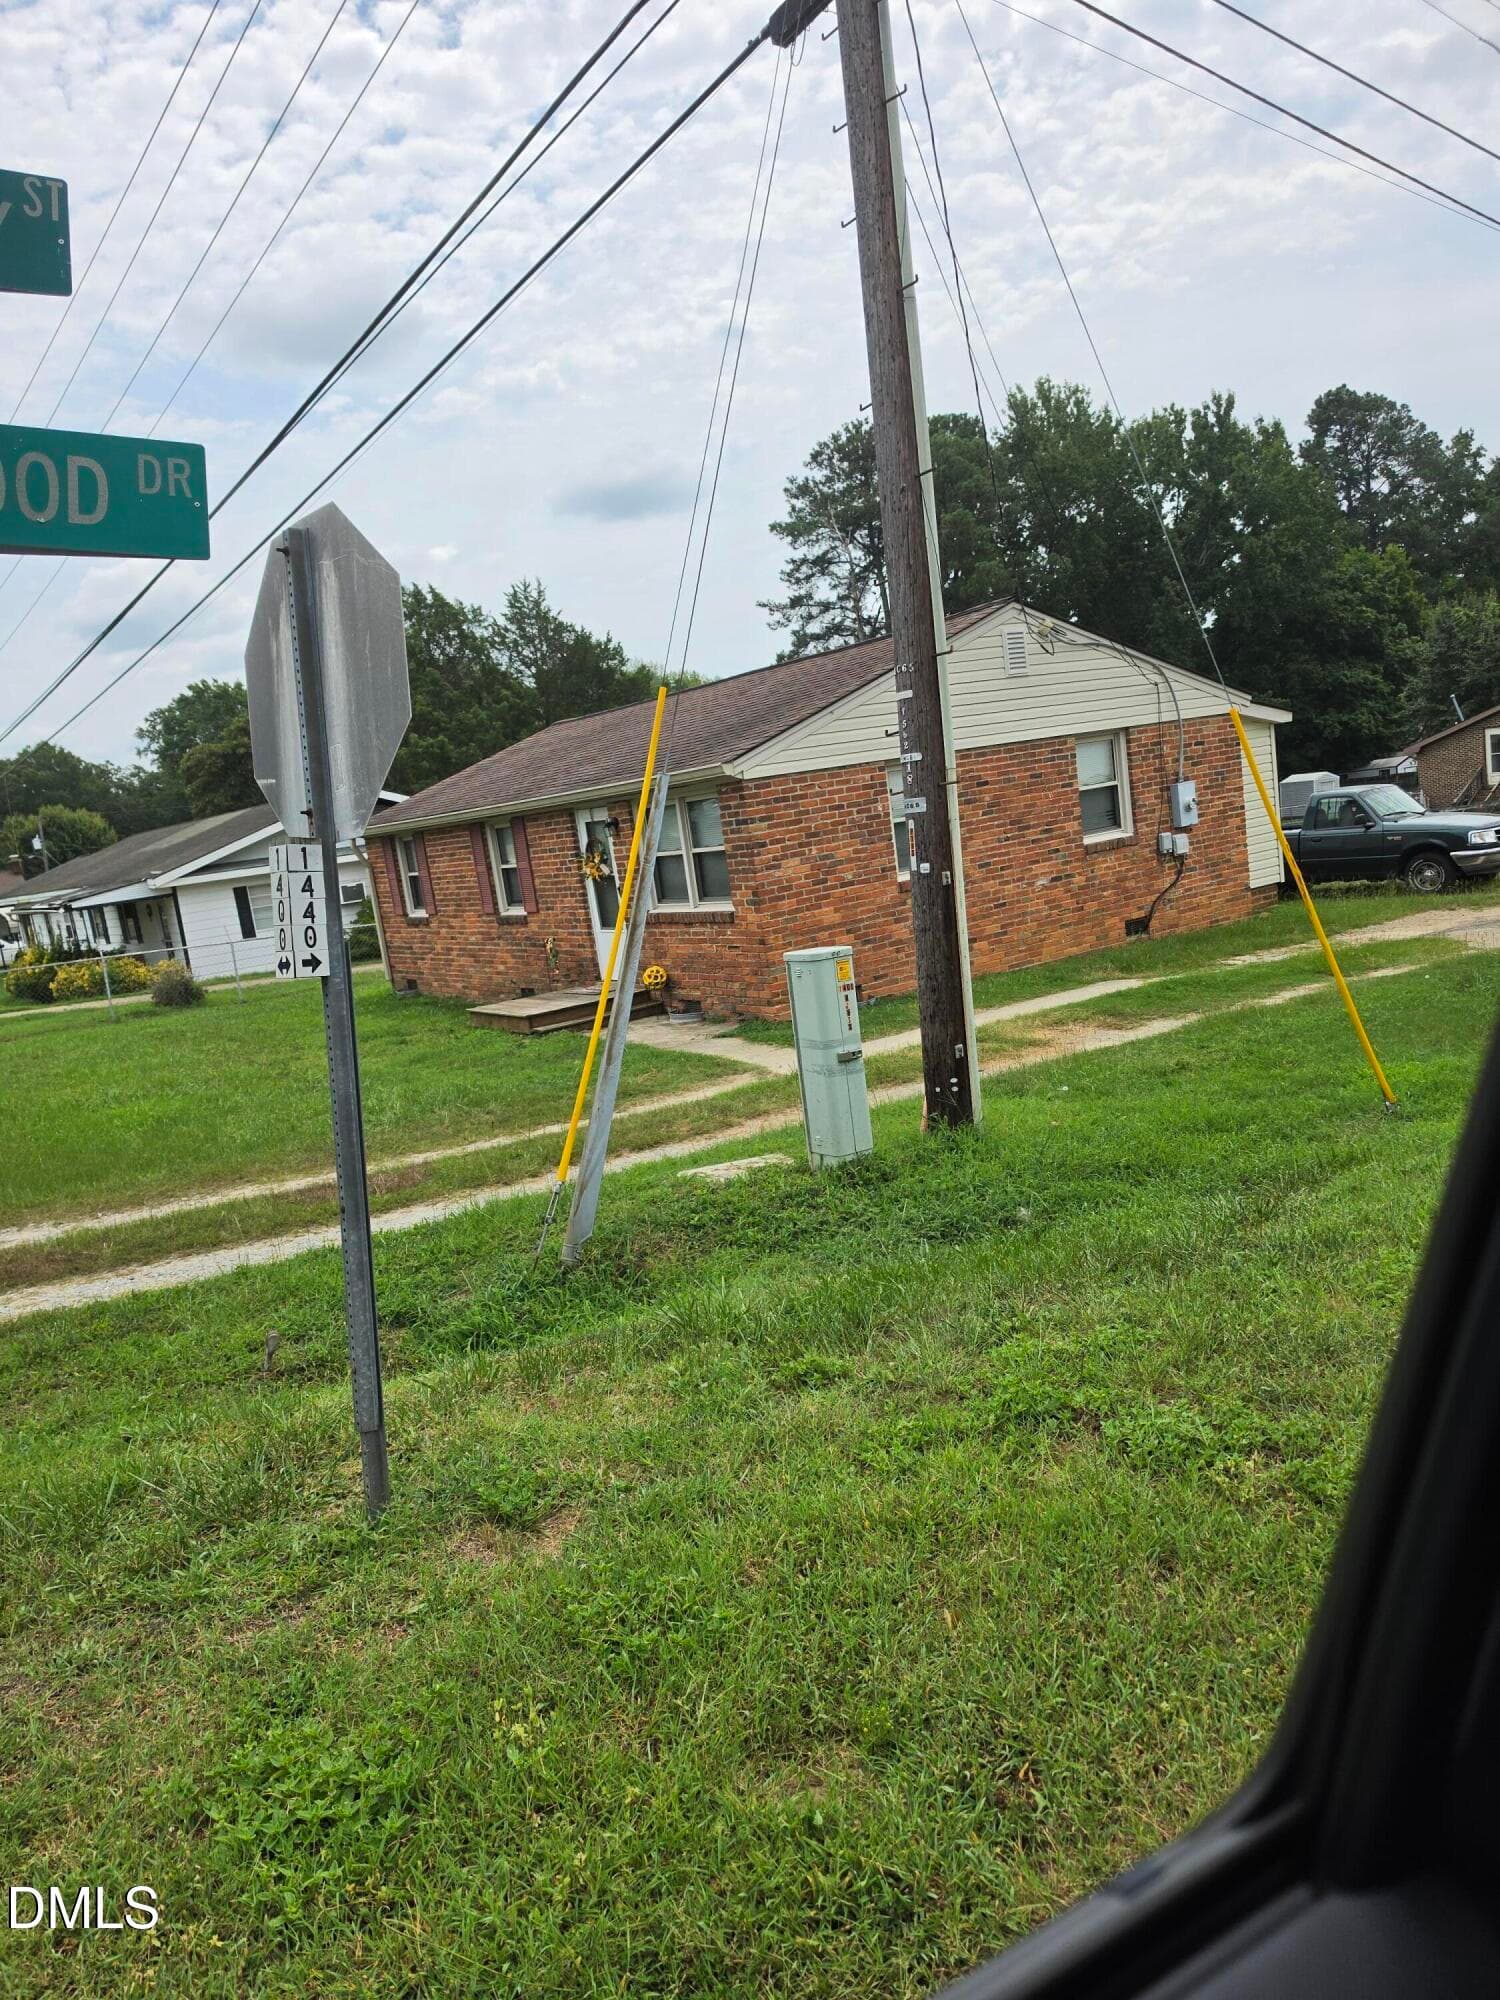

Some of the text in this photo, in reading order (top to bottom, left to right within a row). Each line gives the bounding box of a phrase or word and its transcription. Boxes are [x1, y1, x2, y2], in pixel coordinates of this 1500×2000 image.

[23, 176, 63, 221] ST
[0, 452, 193, 525] OD DR
[276, 848, 286, 950] 1400
[300, 847, 317, 948] 1440
